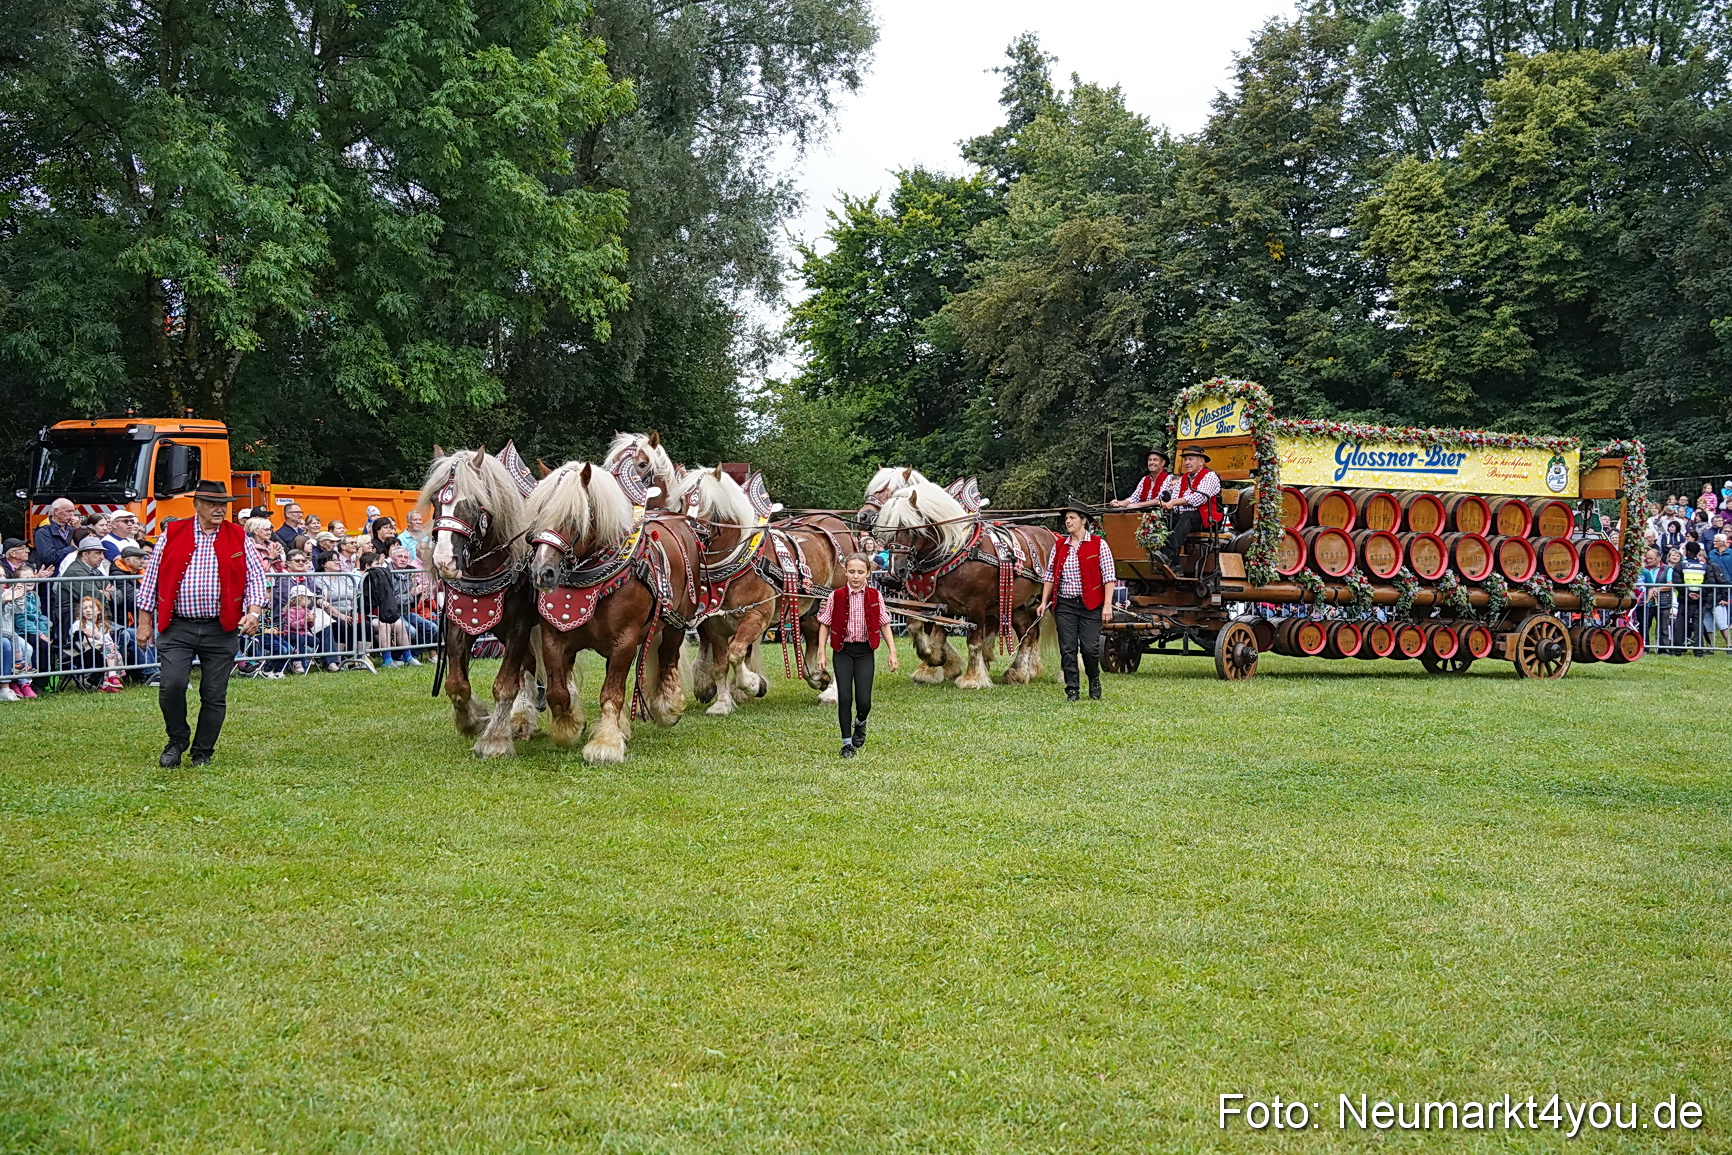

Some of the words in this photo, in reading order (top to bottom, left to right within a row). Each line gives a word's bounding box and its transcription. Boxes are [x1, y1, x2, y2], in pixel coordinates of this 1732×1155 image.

[1194, 400, 1237, 437] Glossner
[1216, 420, 1236, 434] Bier
[1282, 449, 1298, 463] Seit
[1297, 457, 1314, 465] 1574
[1334, 440, 1467, 482] Glossner-Bier
[1483, 454, 1499, 466] Der
[1500, 456, 1533, 470] hochfeine
[1487, 467, 1529, 482] Biergenuss
[1320, 551, 1344, 559] 87002
